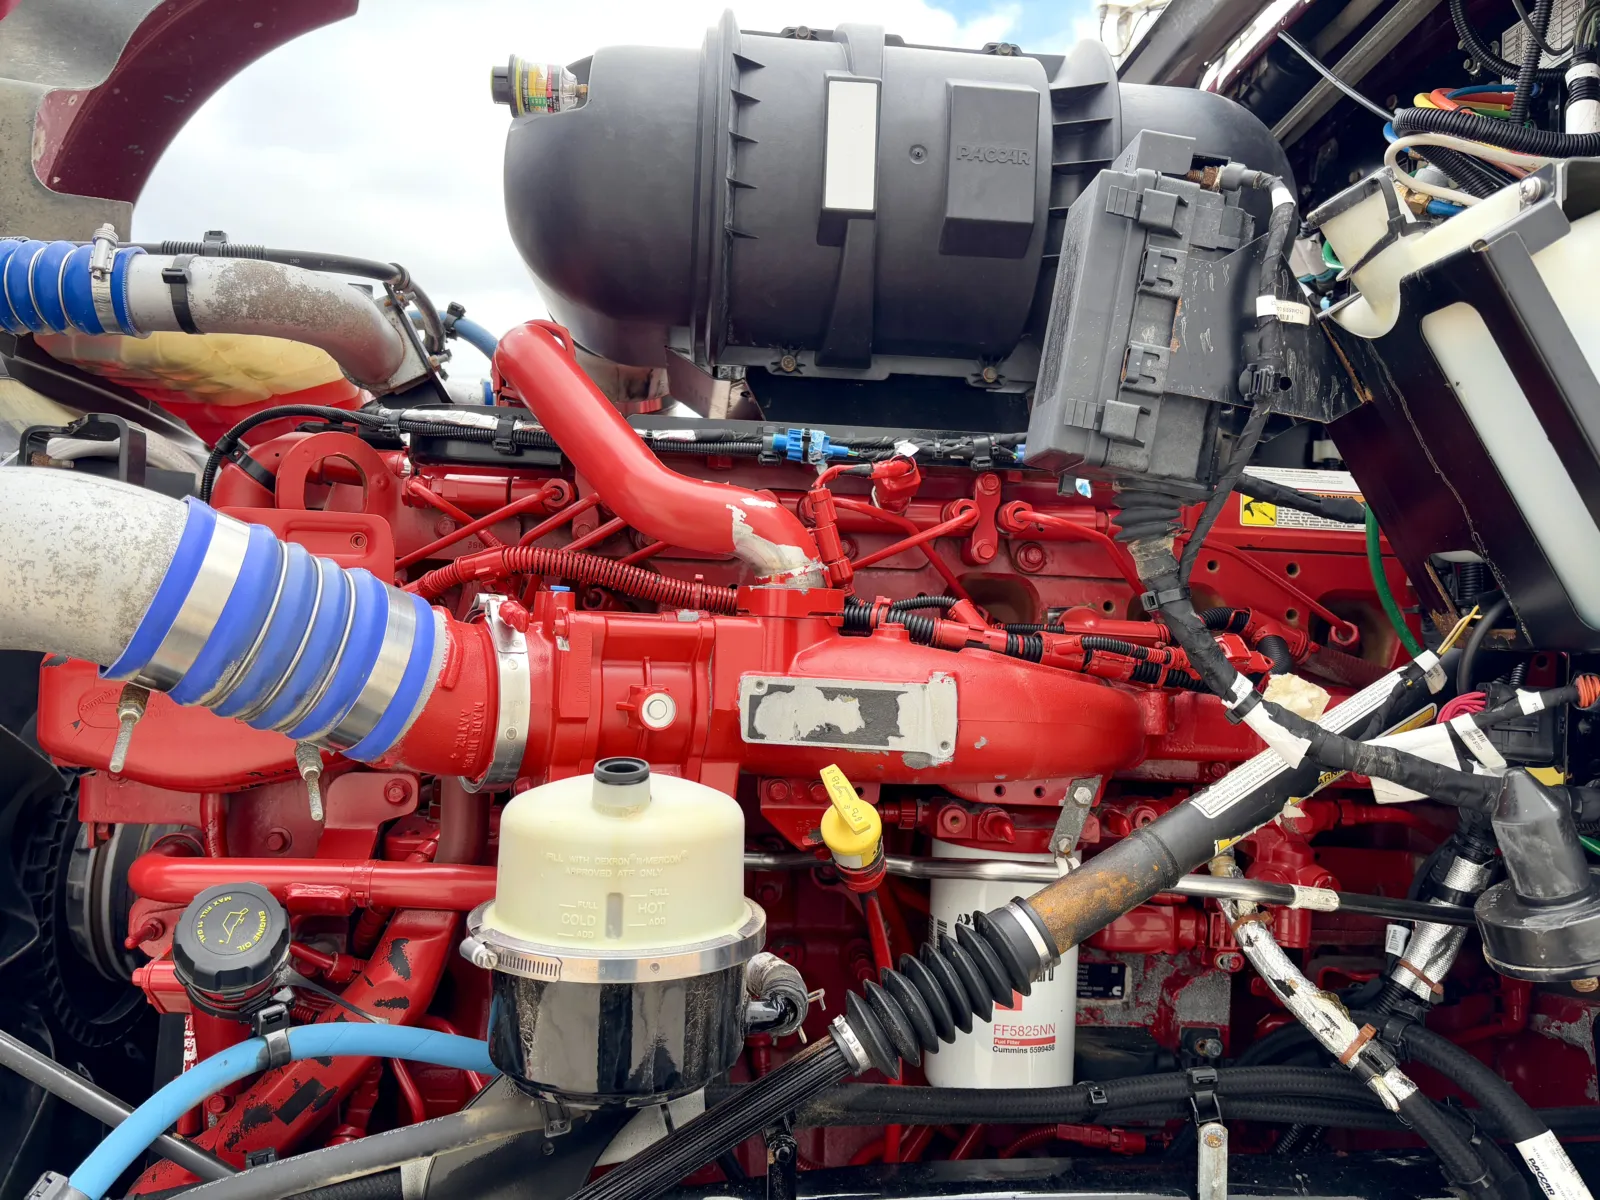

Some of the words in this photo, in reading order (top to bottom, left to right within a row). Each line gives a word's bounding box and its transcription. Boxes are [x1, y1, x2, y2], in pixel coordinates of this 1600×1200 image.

[957, 145, 1030, 165] PACCAR
[472, 702, 484, 735] MADE
[546, 852, 564, 862] FILL
[569, 855, 589, 864] WITH
[565, 868, 612, 878] APPROVED
[617, 869, 635, 877] ATF
[640, 868, 663, 878] ONLY
[649, 888, 670, 896] FULL
[213, 896, 232, 906] MAX
[577, 900, 598, 909] FULL
[200, 906, 212, 919] FILL
[638, 901, 666, 914] HOT
[253, 910, 267, 942] ENGINE
[561, 913, 596, 927] COLD
[649, 917, 666, 926] ADD
[197, 929, 207, 944] GAL
[576, 931, 594, 939] ADD
[237, 941, 252, 952] OIL
[993, 1022, 1056, 1037] FF5825NN
[992, 1045, 1028, 1054] Cummins
[1528, 1157, 1556, 1196] PACCAR
